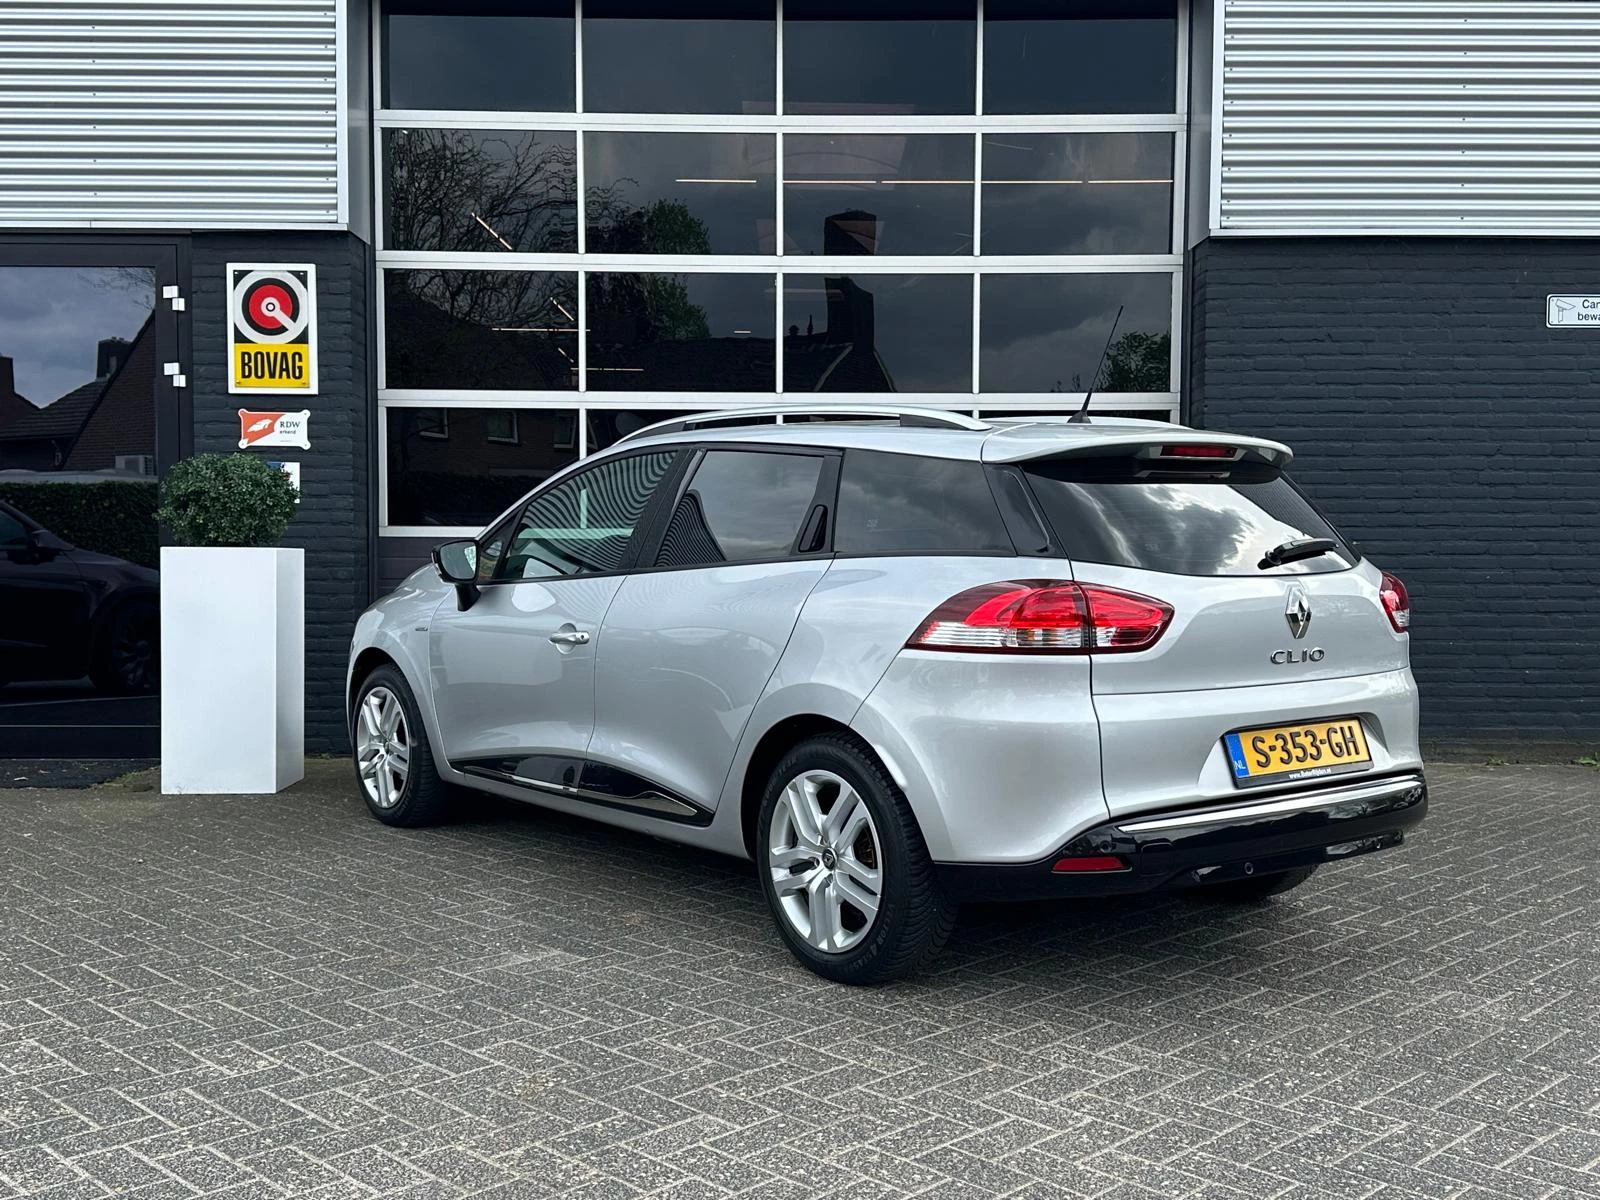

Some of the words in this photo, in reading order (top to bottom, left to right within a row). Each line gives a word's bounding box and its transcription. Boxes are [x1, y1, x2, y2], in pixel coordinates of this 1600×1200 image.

[240, 350, 303, 380] BOVAG
[279, 420, 301, 428] RDW
[1270, 646, 1325, 665] CLIO
[1251, 725, 1360, 769] S-353-GH
[1234, 760, 1246, 770] NL
